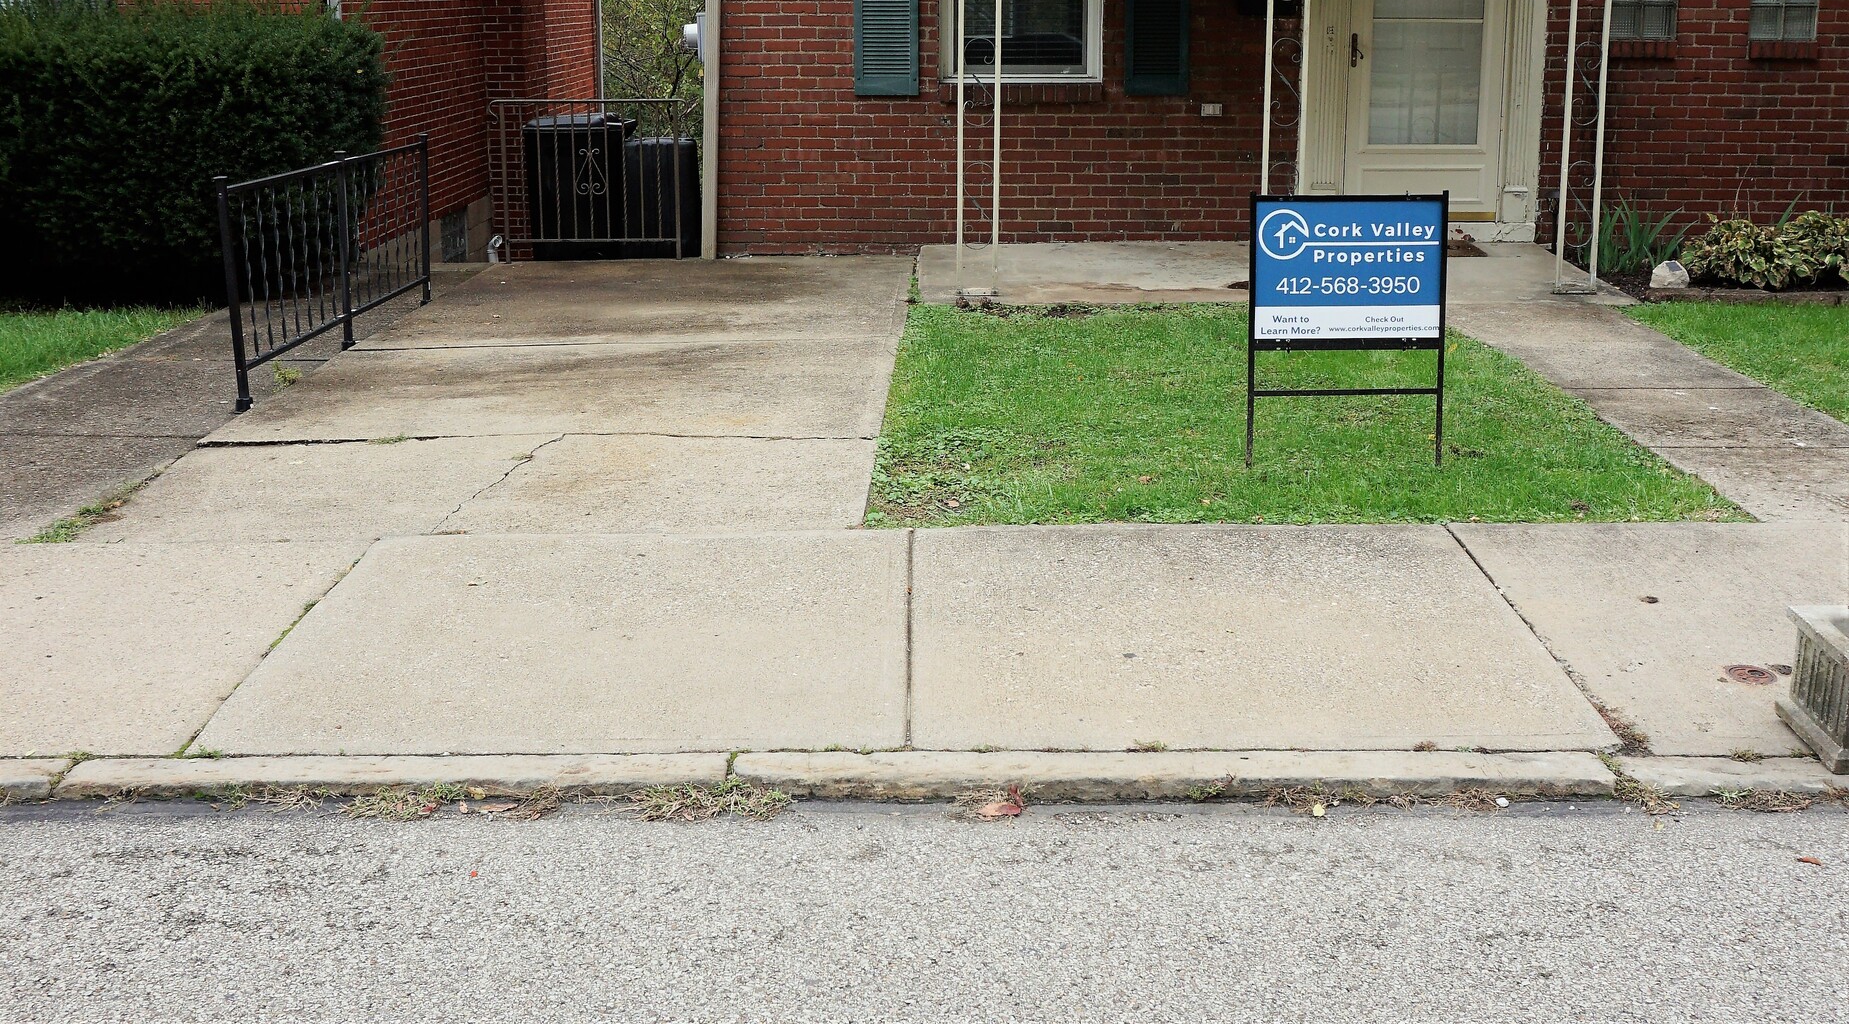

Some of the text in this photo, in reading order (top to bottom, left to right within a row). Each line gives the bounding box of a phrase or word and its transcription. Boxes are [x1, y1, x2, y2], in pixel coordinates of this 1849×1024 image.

[1314, 222, 1435, 239] Cork Valley
[1313, 248, 1425, 266] Properties
[1276, 276, 1420, 294] 412-568-3950
[1272, 315, 1309, 323] Want to
[1261, 326, 1321, 335] Learn More?
